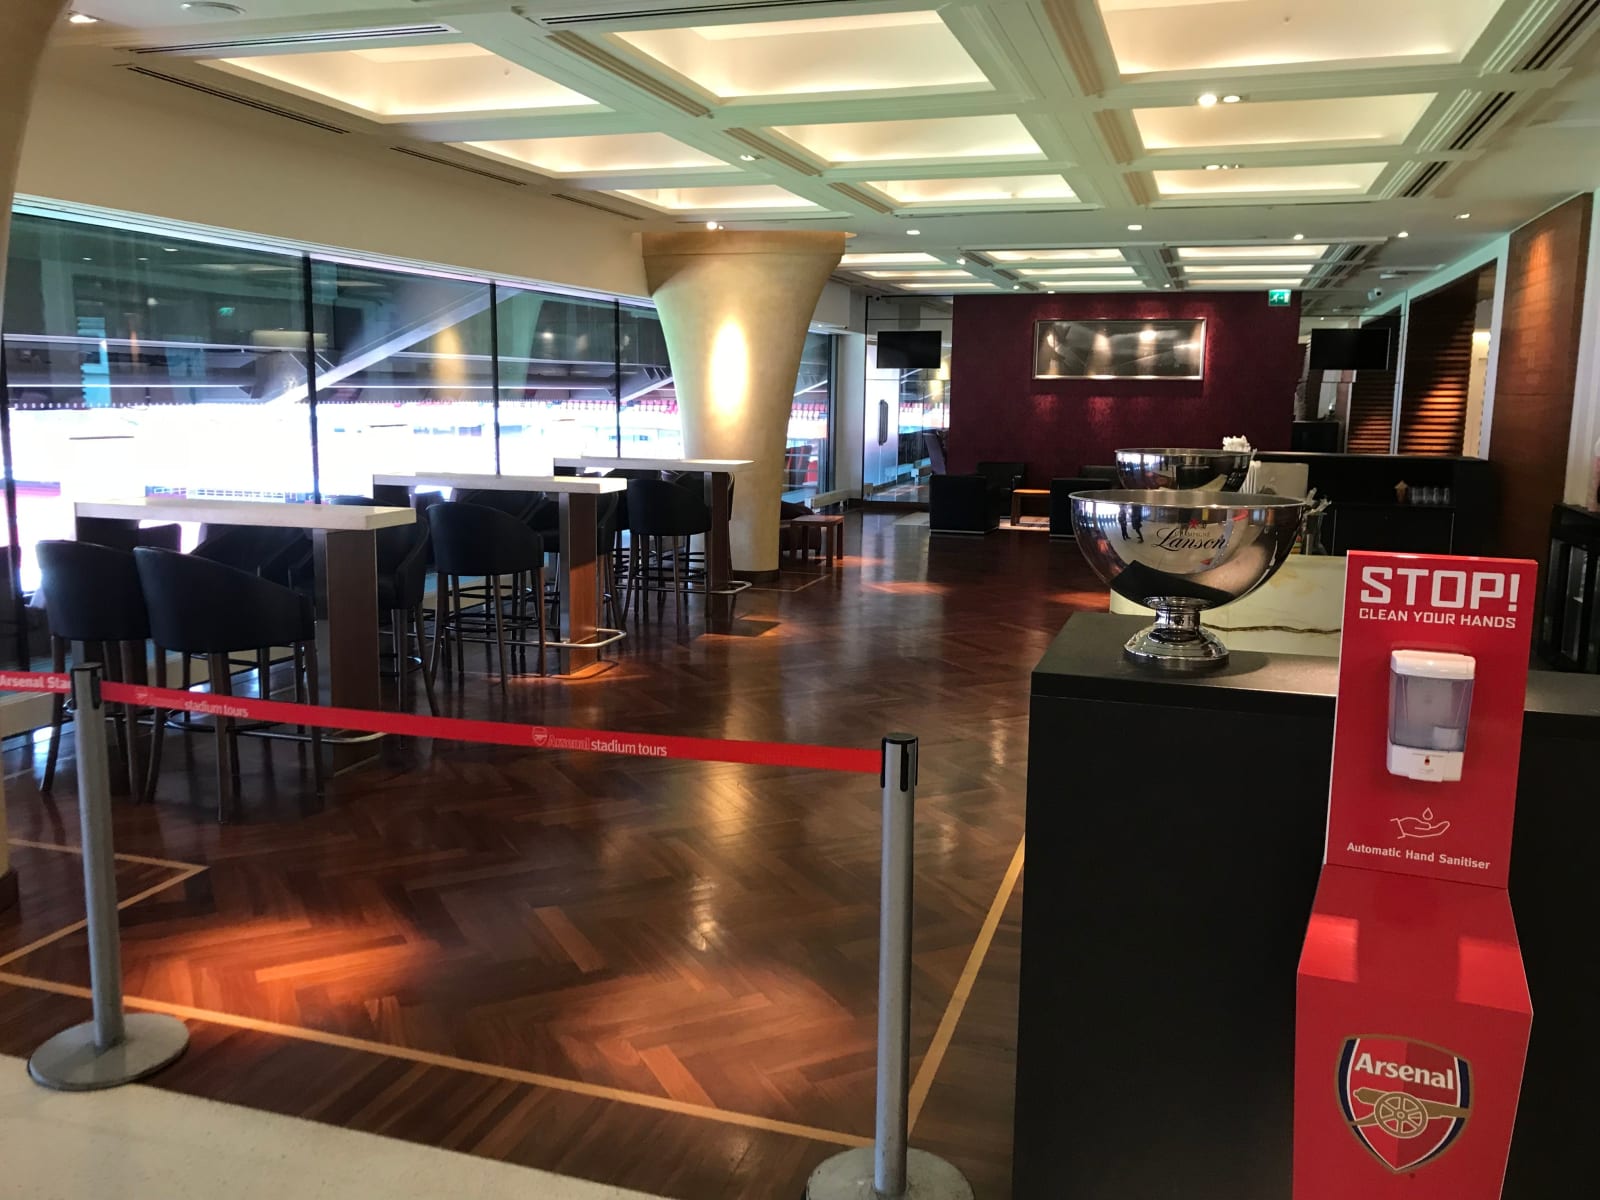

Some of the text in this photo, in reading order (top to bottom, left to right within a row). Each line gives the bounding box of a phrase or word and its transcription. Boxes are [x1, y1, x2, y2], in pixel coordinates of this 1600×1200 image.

[1151, 527, 1226, 552] Lanson
[1361, 566, 1520, 612] STOP!
[1359, 608, 1517, 629] CLEAN YOUR HANDS
[0, 674, 44, 688] Arsenal
[184, 700, 222, 714] stadium
[223, 704, 249, 717] tours
[591, 739, 636, 754] stadium
[638, 743, 667, 757] tours
[1347, 842, 1490, 870] Automatic Hand Sanitiser
[1354, 1053, 1454, 1090] Arsenal
